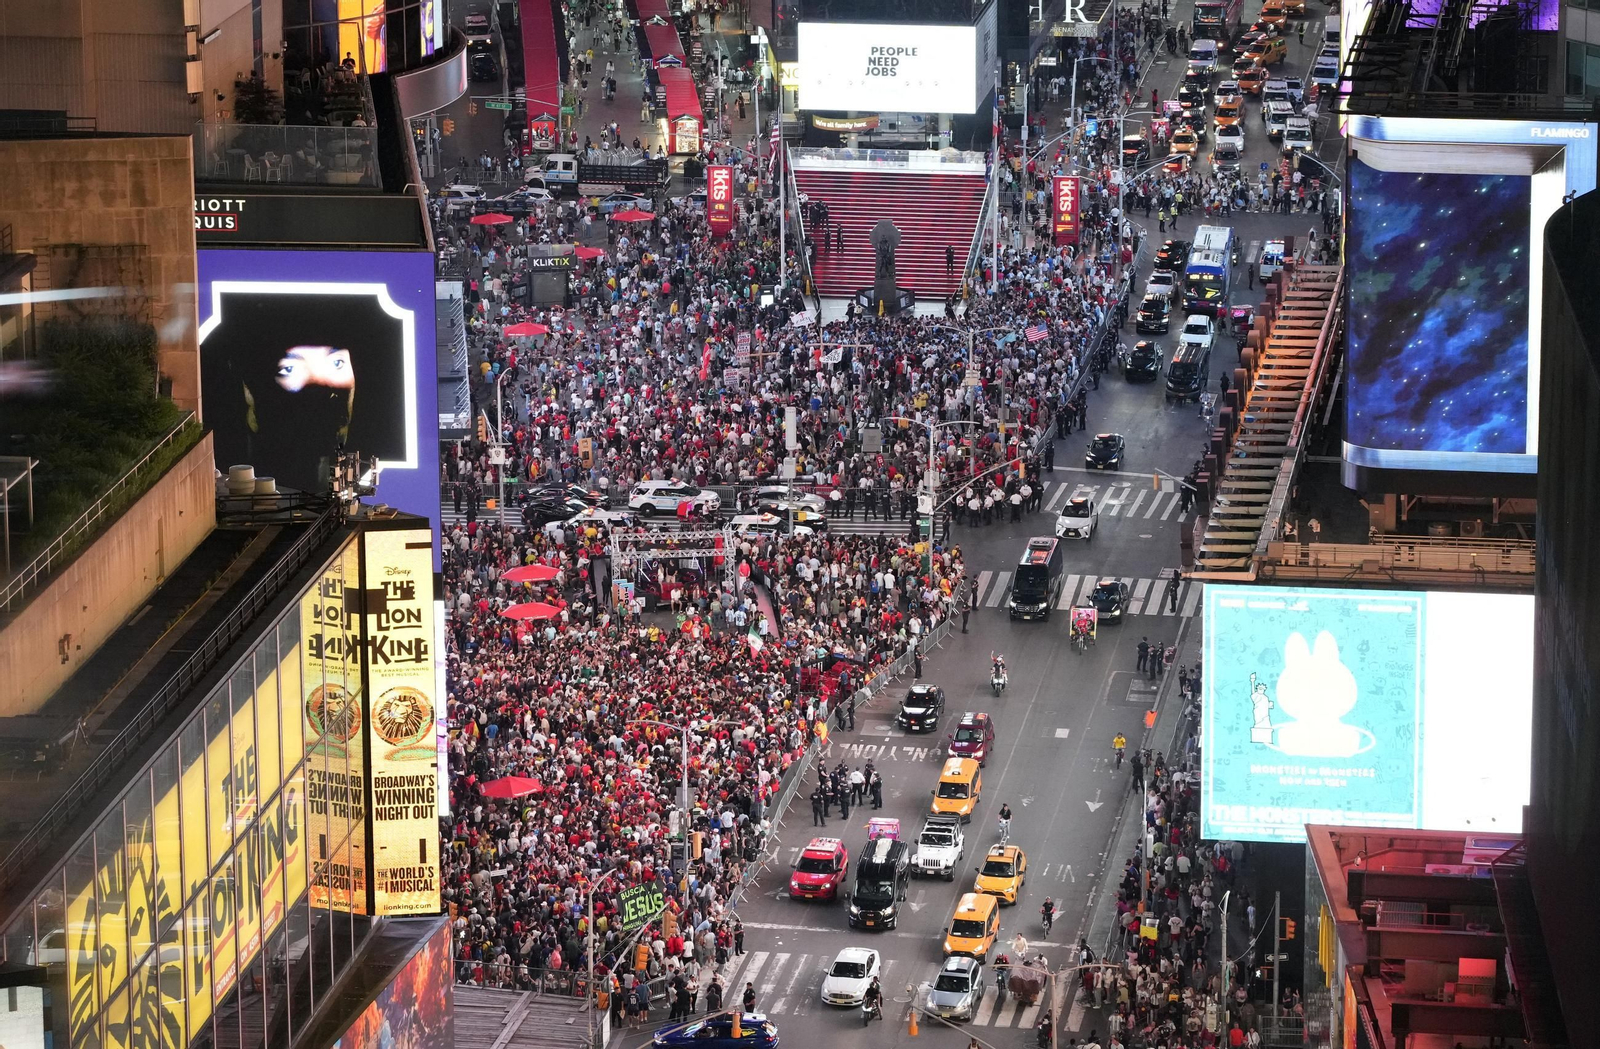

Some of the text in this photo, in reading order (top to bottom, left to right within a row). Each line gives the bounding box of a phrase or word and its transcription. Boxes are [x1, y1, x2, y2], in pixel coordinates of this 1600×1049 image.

[871, 46, 918, 56] PEOPLE
[868, 57, 899, 66] NEED
[865, 67, 897, 76] JOBS
[1530, 128, 1589, 138] FLAMINGO
[714, 168, 730, 200] tkts
[1060, 180, 1075, 211] tkts
[533, 258, 570, 267] KLIKTIX
[384, 566, 411, 576] Disney
[381, 580, 415, 600] THE
[377, 606, 421, 631] LION
[368, 635, 428, 665] KING
[374, 774, 434, 788] BROADWAY'S
[374, 788, 434, 806] WINNING
[375, 805, 434, 821] NIGHT OUT
[378, 866, 434, 880] THE WORLD'S
[390, 879, 434, 893] MUSICAL
[620, 885, 645, 900] BUSCA
[216, 963, 236, 996] ENTRANCE
[240, 947, 248, 963] ON
